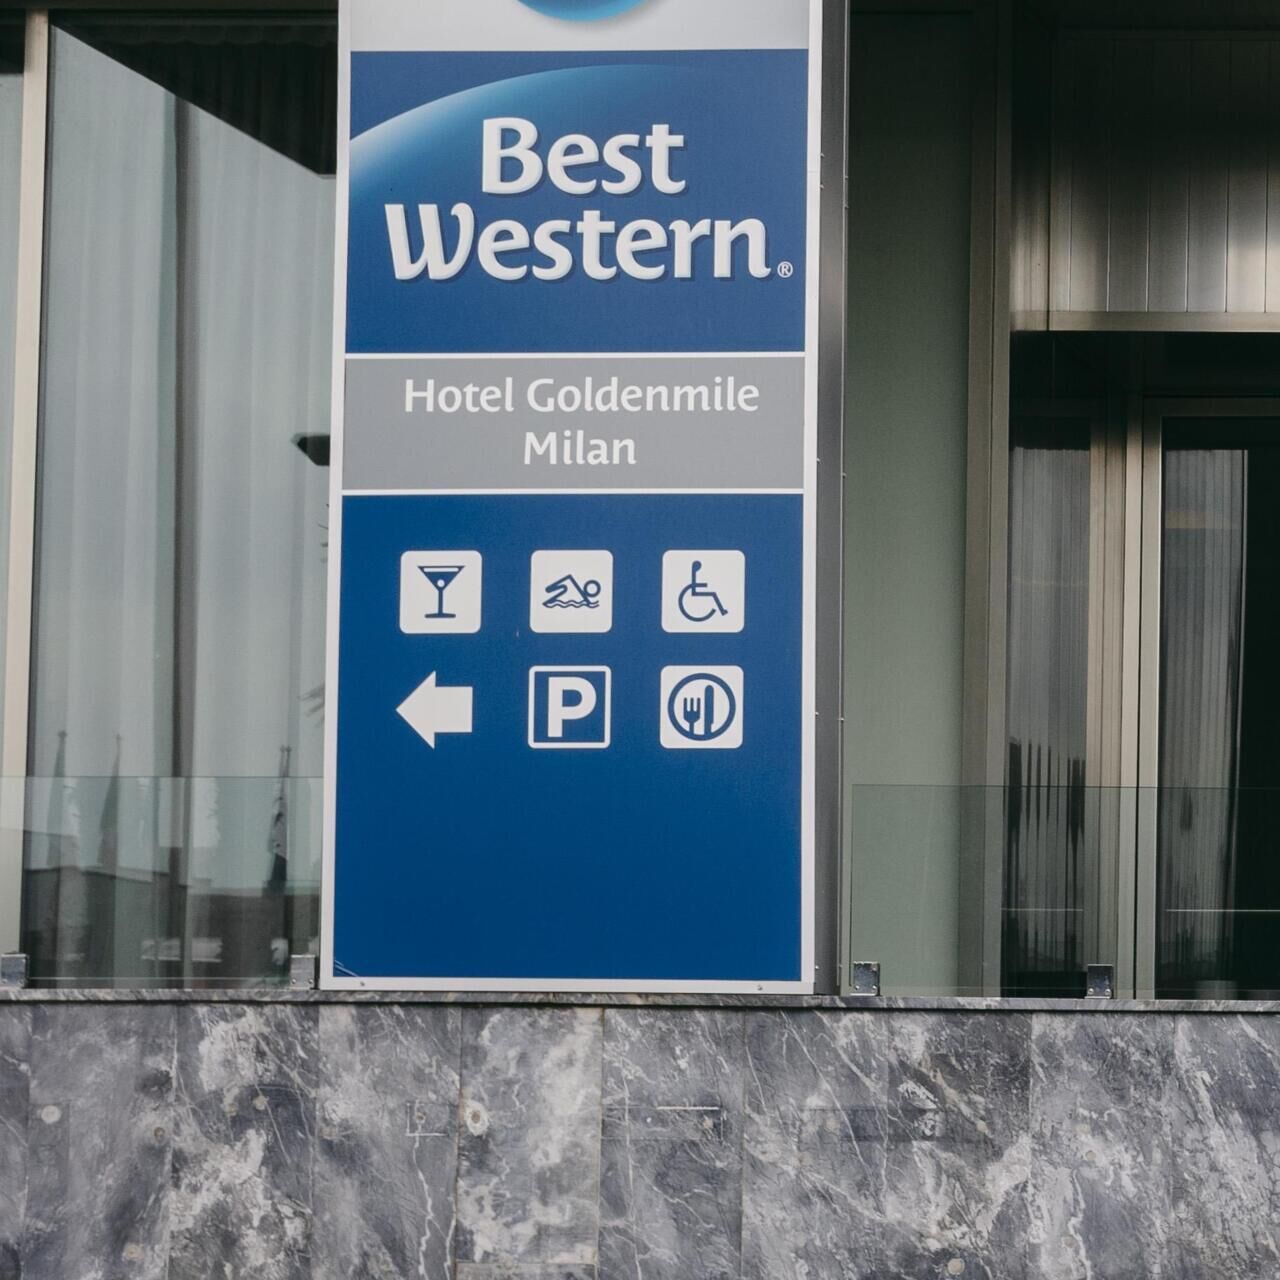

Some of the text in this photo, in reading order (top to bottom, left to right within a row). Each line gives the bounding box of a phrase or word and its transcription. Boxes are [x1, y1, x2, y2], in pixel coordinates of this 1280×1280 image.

[481, 117, 687, 195] Best
[404, 375, 760, 413] Hotel Goldenmile
[524, 429, 637, 465] Milan
